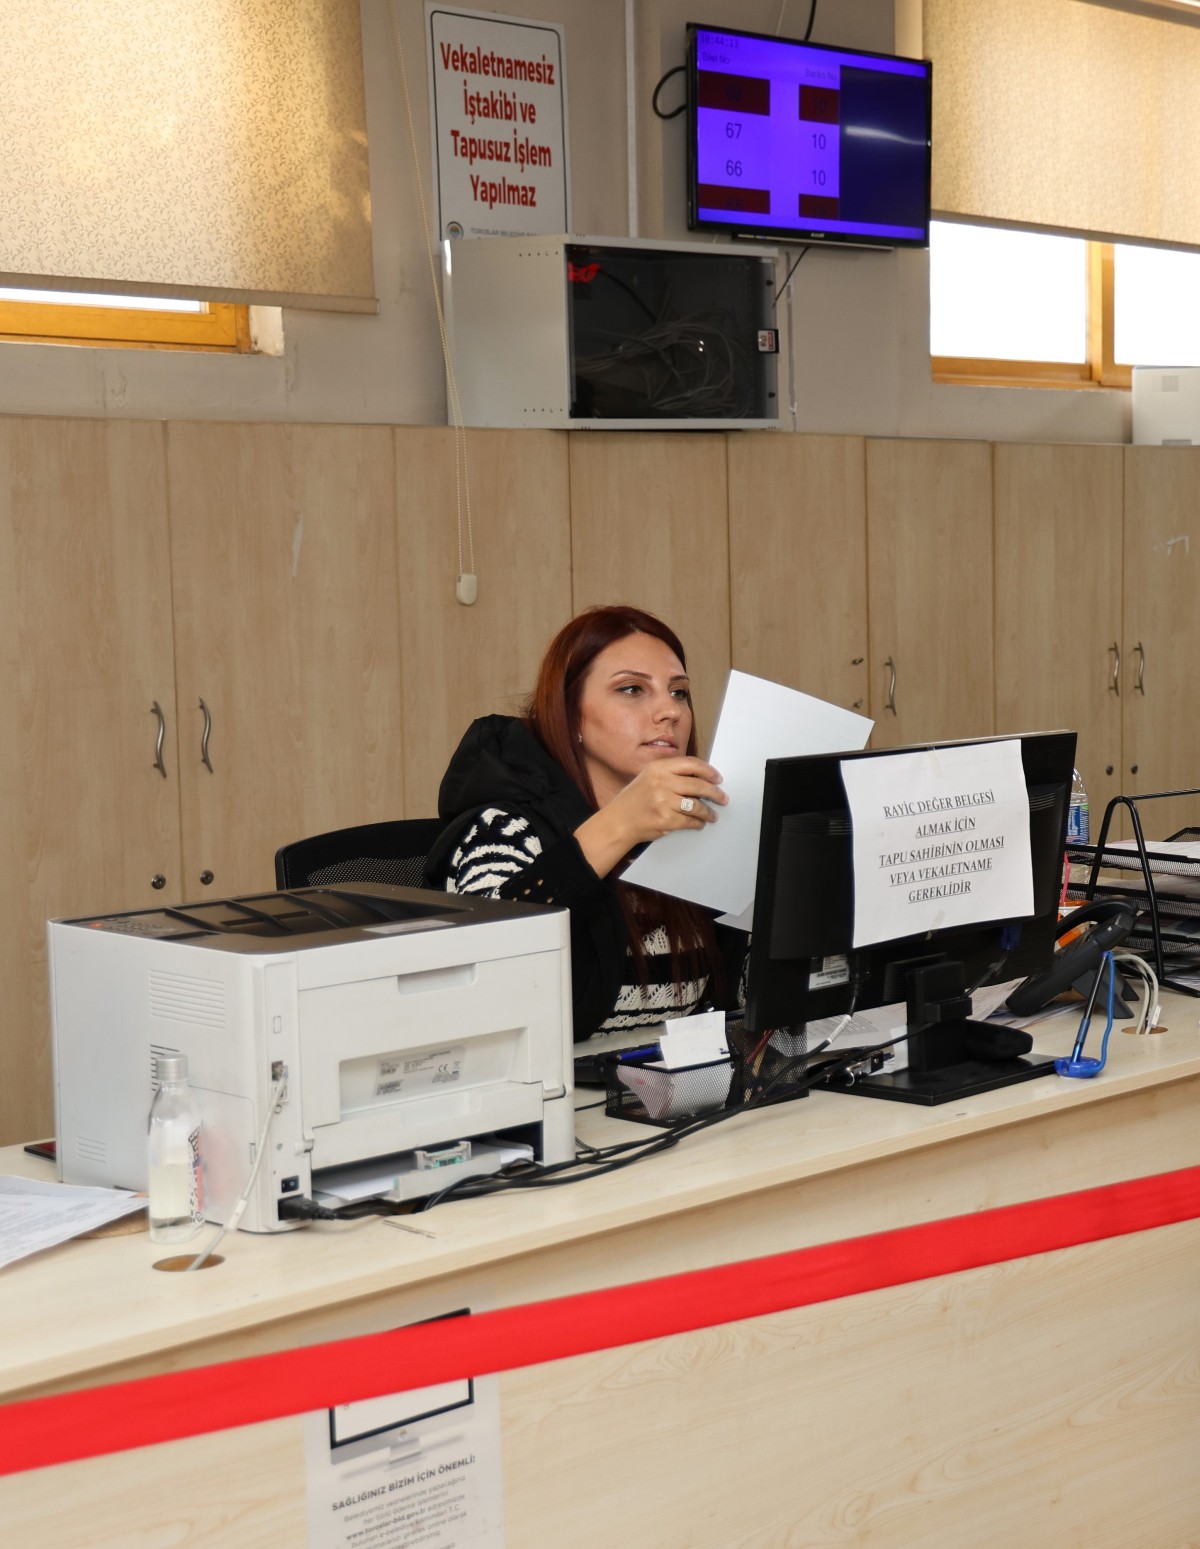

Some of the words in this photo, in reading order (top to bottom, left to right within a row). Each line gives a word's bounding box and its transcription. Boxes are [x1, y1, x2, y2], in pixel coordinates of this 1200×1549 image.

[440, 42, 555, 85] Vekaletnamesiz
[463, 79, 517, 125] İştakibi
[519, 102, 536, 124] ve
[725, 122, 742, 140] 67
[811, 134, 826, 150] 10
[450, 130, 511, 165] Tapusuz
[513, 128, 552, 173] İşlem
[725, 160, 743, 177] 66
[811, 170, 826, 186] 10
[470, 174, 537, 209] Yapılmaz
[883, 799, 916, 819] RAYİÇ
[918, 795, 953, 815] DEĞER
[954, 788, 996, 808] BELGESİ
[915, 819, 952, 838] ALMAK
[954, 816, 976, 834] İÇİN
[879, 851, 908, 868] TAPU
[909, 842, 964, 864] SAHİBİNİN
[965, 835, 1005, 853] OLMASI
[889, 870, 916, 887] VEYA
[918, 858, 993, 881] VEKALETNAME
[908, 881, 972, 904] GEREKLİDİR
[332, 1486, 386, 1511] SAĞLIĞINIZ
[388, 1474, 415, 1492] BİZİM
[417, 1468, 436, 1483] İÇİN
[438, 1455, 476, 1475] ÖNEMLİ!
